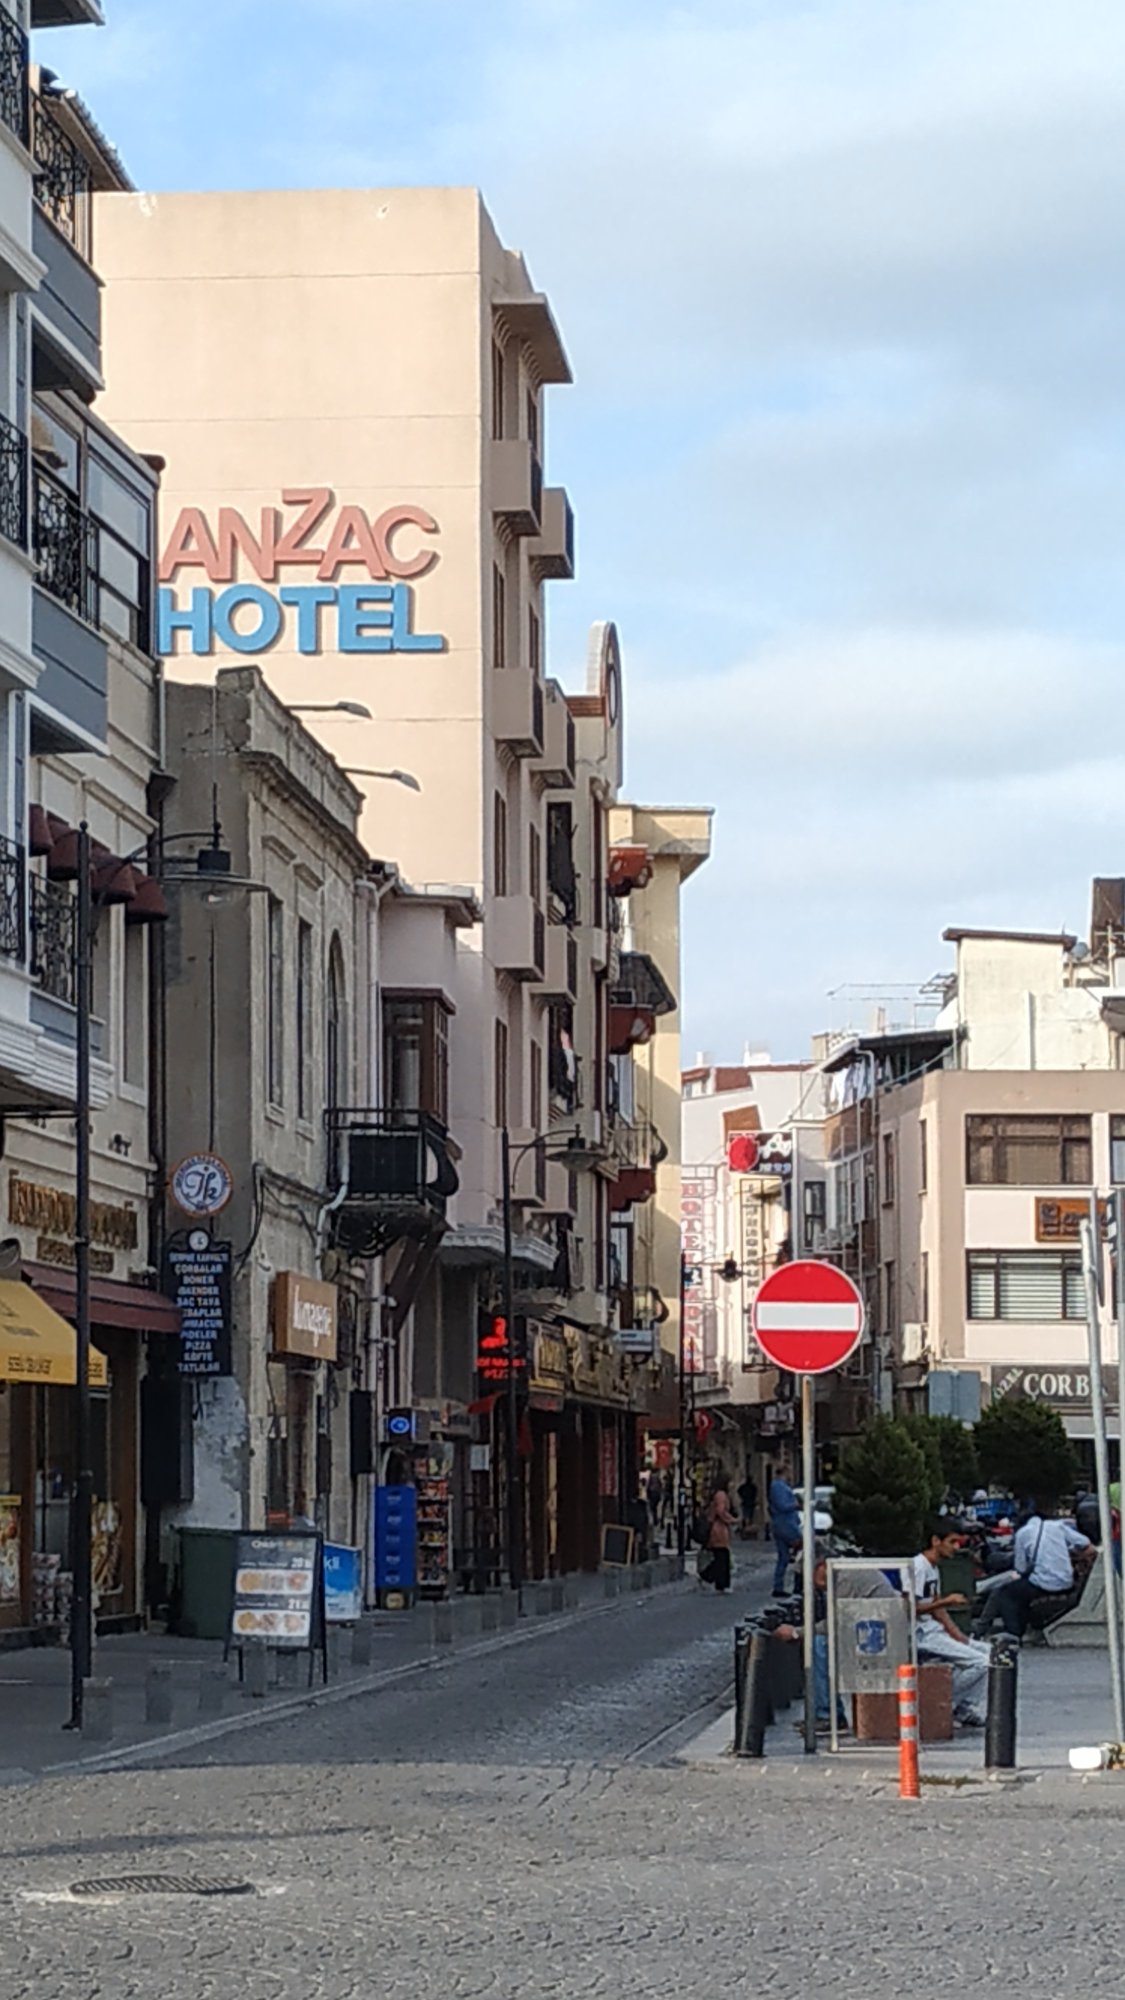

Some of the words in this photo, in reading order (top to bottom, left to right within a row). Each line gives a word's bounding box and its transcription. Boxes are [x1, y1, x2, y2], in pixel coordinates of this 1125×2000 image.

[158, 487, 439, 582] ANZAC
[158, 583, 447, 655] HOTEL
[1022, 1372, 1108, 1401] ÇORB
